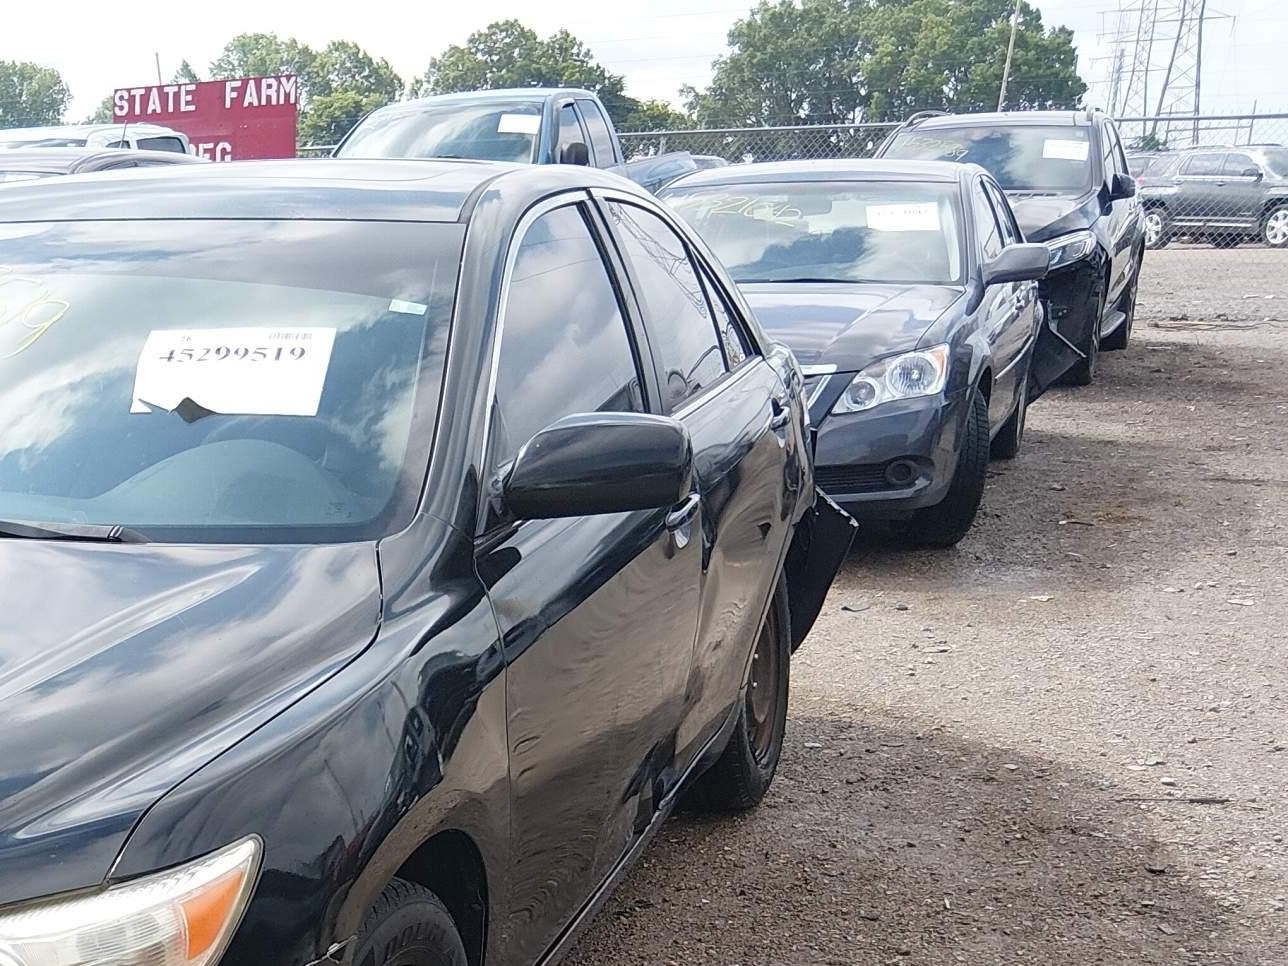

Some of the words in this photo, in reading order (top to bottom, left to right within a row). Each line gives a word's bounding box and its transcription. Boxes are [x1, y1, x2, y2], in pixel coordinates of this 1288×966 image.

[114, 84, 197, 117] STATE
[224, 76, 296, 109] FARM
[159, 345, 307, 363] 45299519
